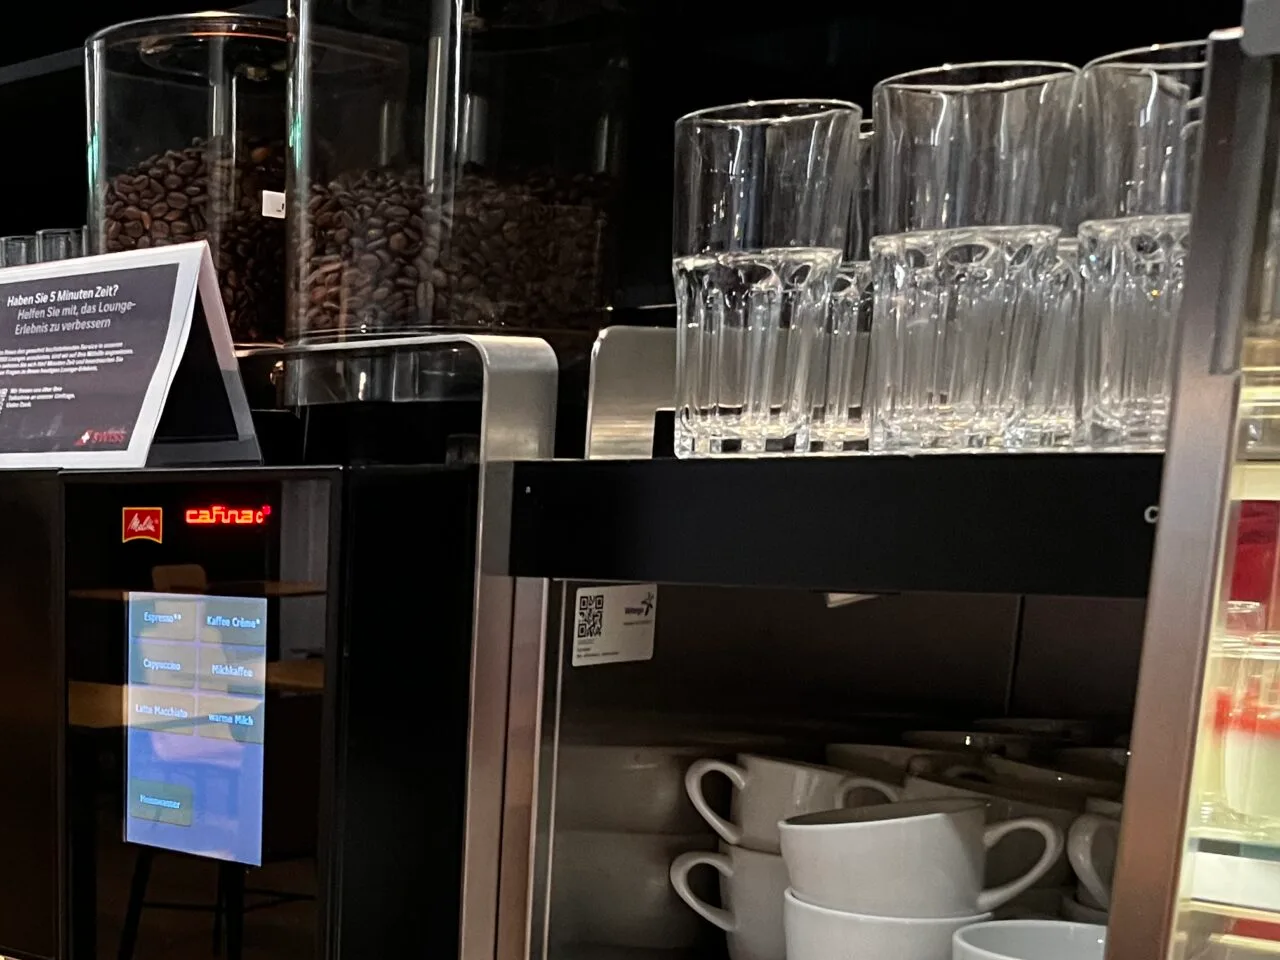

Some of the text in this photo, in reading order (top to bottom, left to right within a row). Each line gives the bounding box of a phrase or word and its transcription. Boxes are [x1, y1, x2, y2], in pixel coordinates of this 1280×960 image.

[6, 284, 119, 307] Haben Sie 5 Minuten Zeit?
[17, 301, 137, 320] Helfen Sie mit, das Lounge-
[14, 318, 112, 336] Erlebnis zu verbessern
